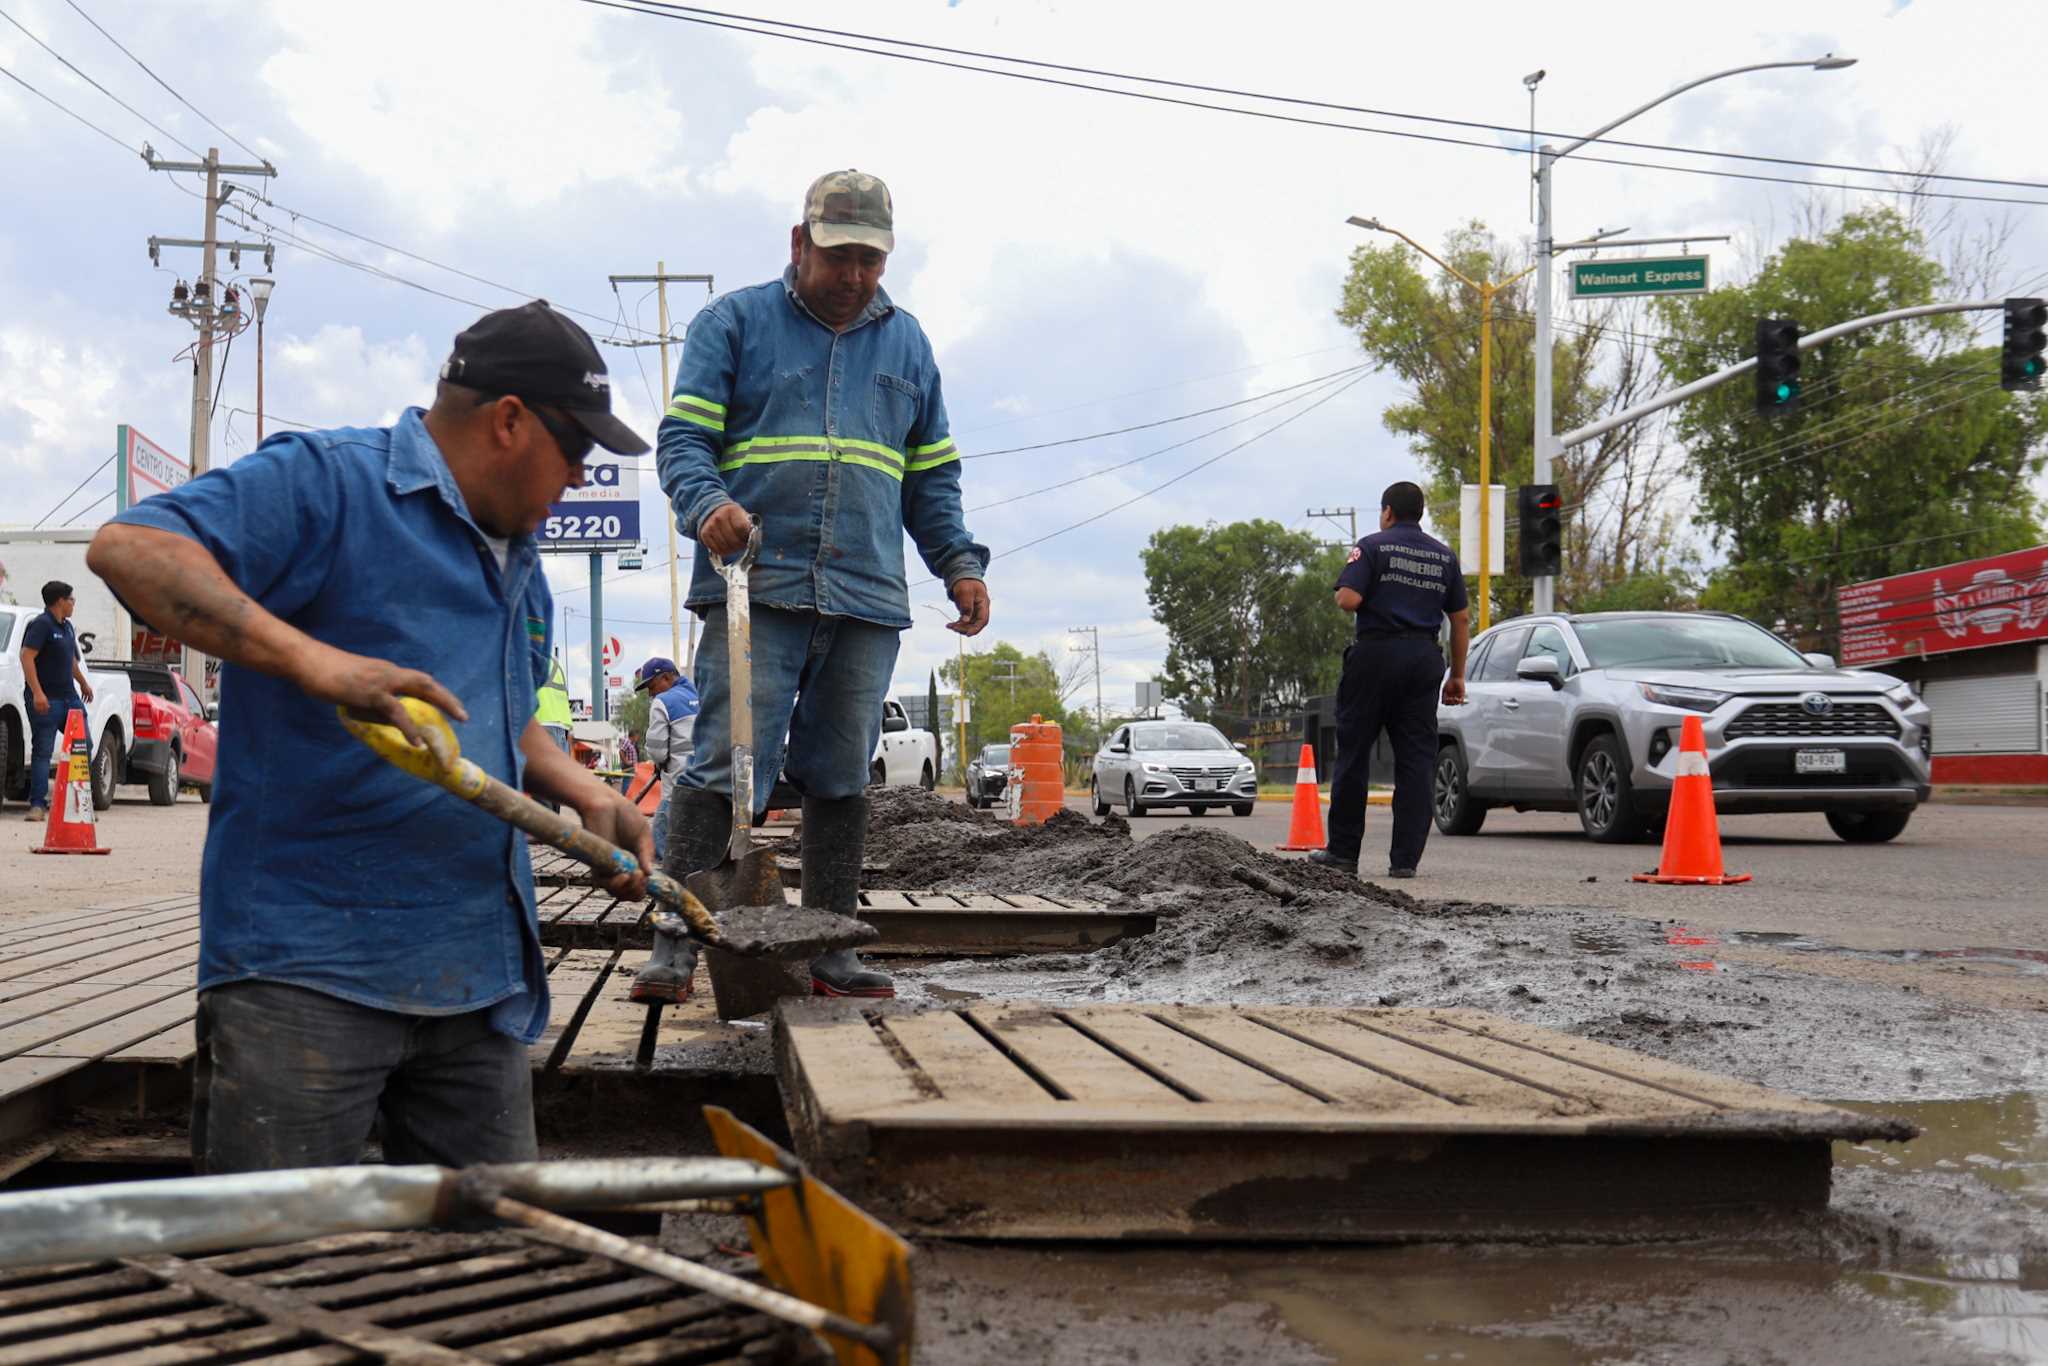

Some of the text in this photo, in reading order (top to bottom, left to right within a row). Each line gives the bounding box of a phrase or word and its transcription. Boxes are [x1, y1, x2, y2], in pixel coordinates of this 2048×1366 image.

[1580, 270, 1700, 286] Walmart Express
[136, 445, 165, 480] CENTRO
[165, 464, 174, 486] DE
[578, 488, 621, 498] media
[544, 515, 621, 539] 5220
[1379, 544, 1440, 560] DEPARTAMENTO
[1389, 556, 1443, 577] BOMBEROS
